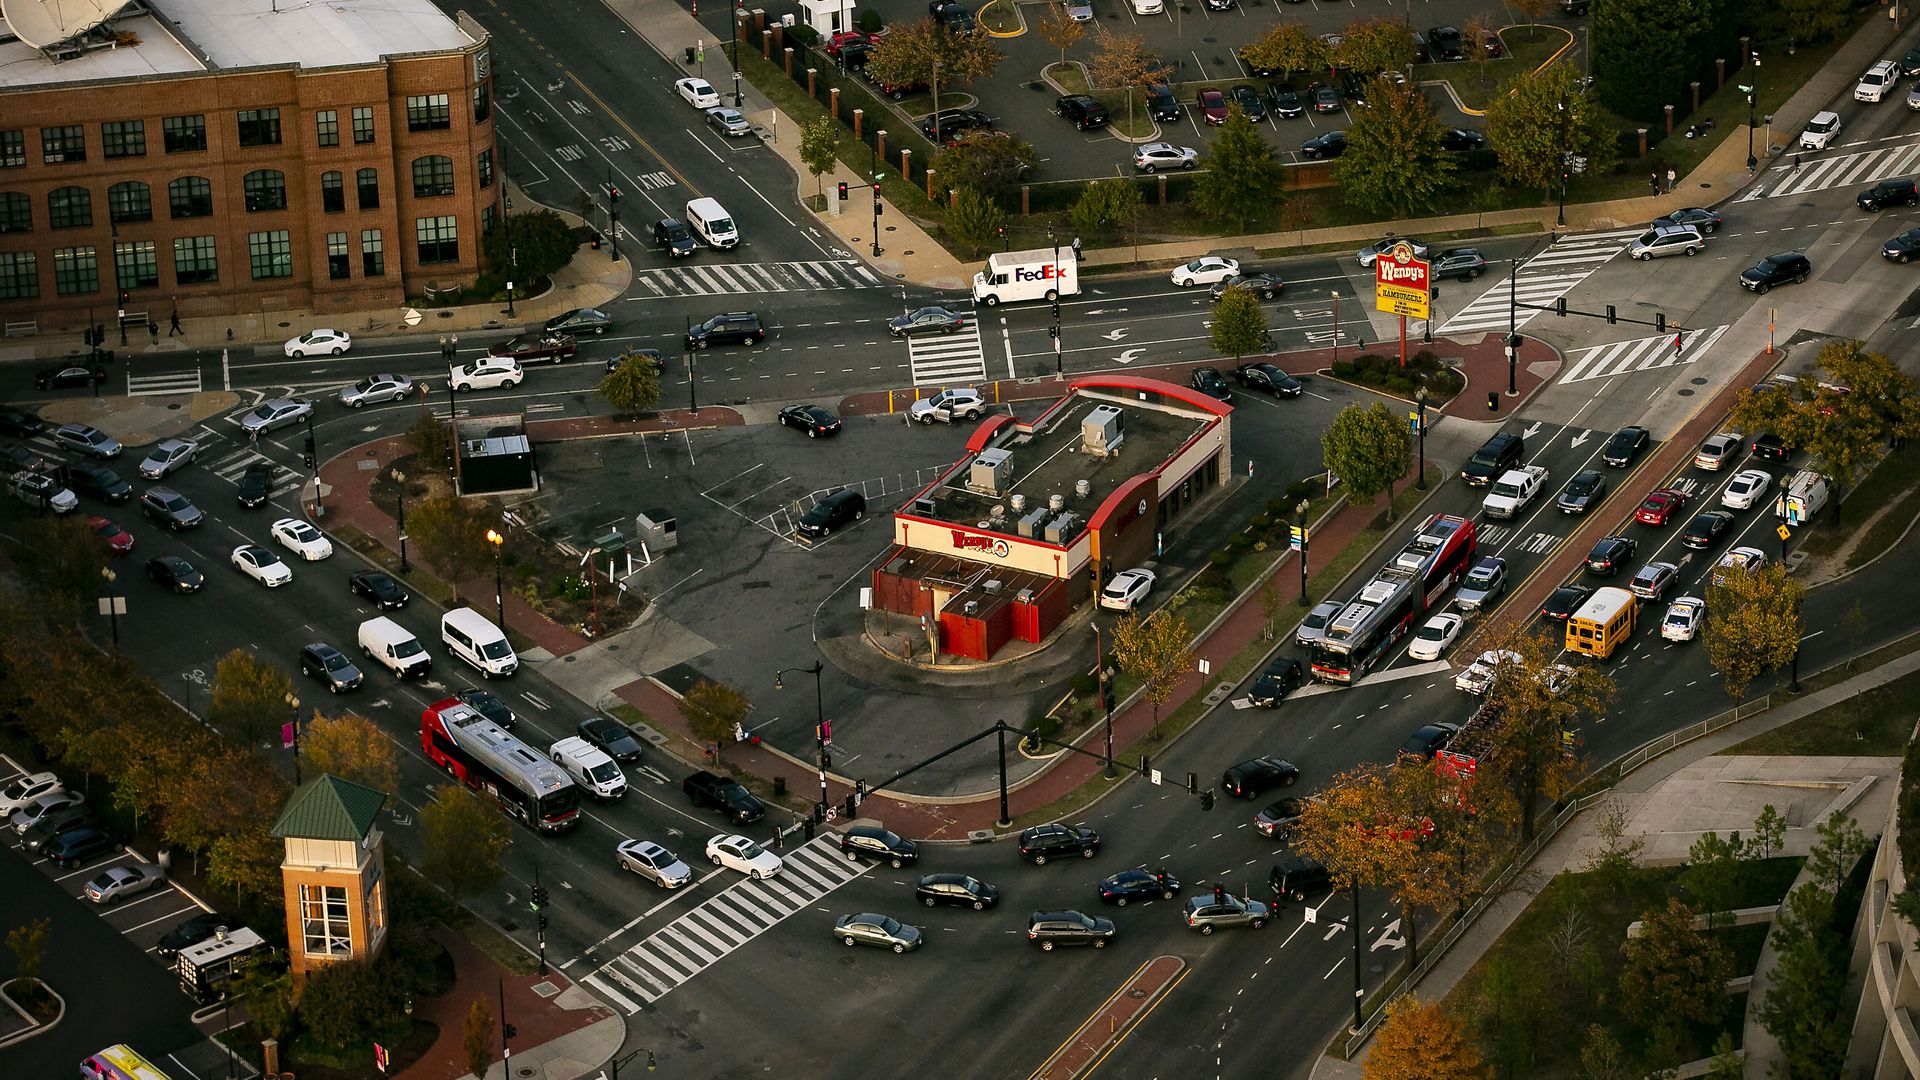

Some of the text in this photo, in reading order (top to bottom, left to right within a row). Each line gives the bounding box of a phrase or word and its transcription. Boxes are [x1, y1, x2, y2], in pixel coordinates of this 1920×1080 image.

[600, 136, 632, 152] AVE
[637, 170, 676, 190] ONLY
[1015, 264, 1067, 282] FedEx
[1380, 260, 1424, 281] Wendy's
[1476, 523, 1511, 545] ONL
[1515, 532, 1563, 554] ONLY
